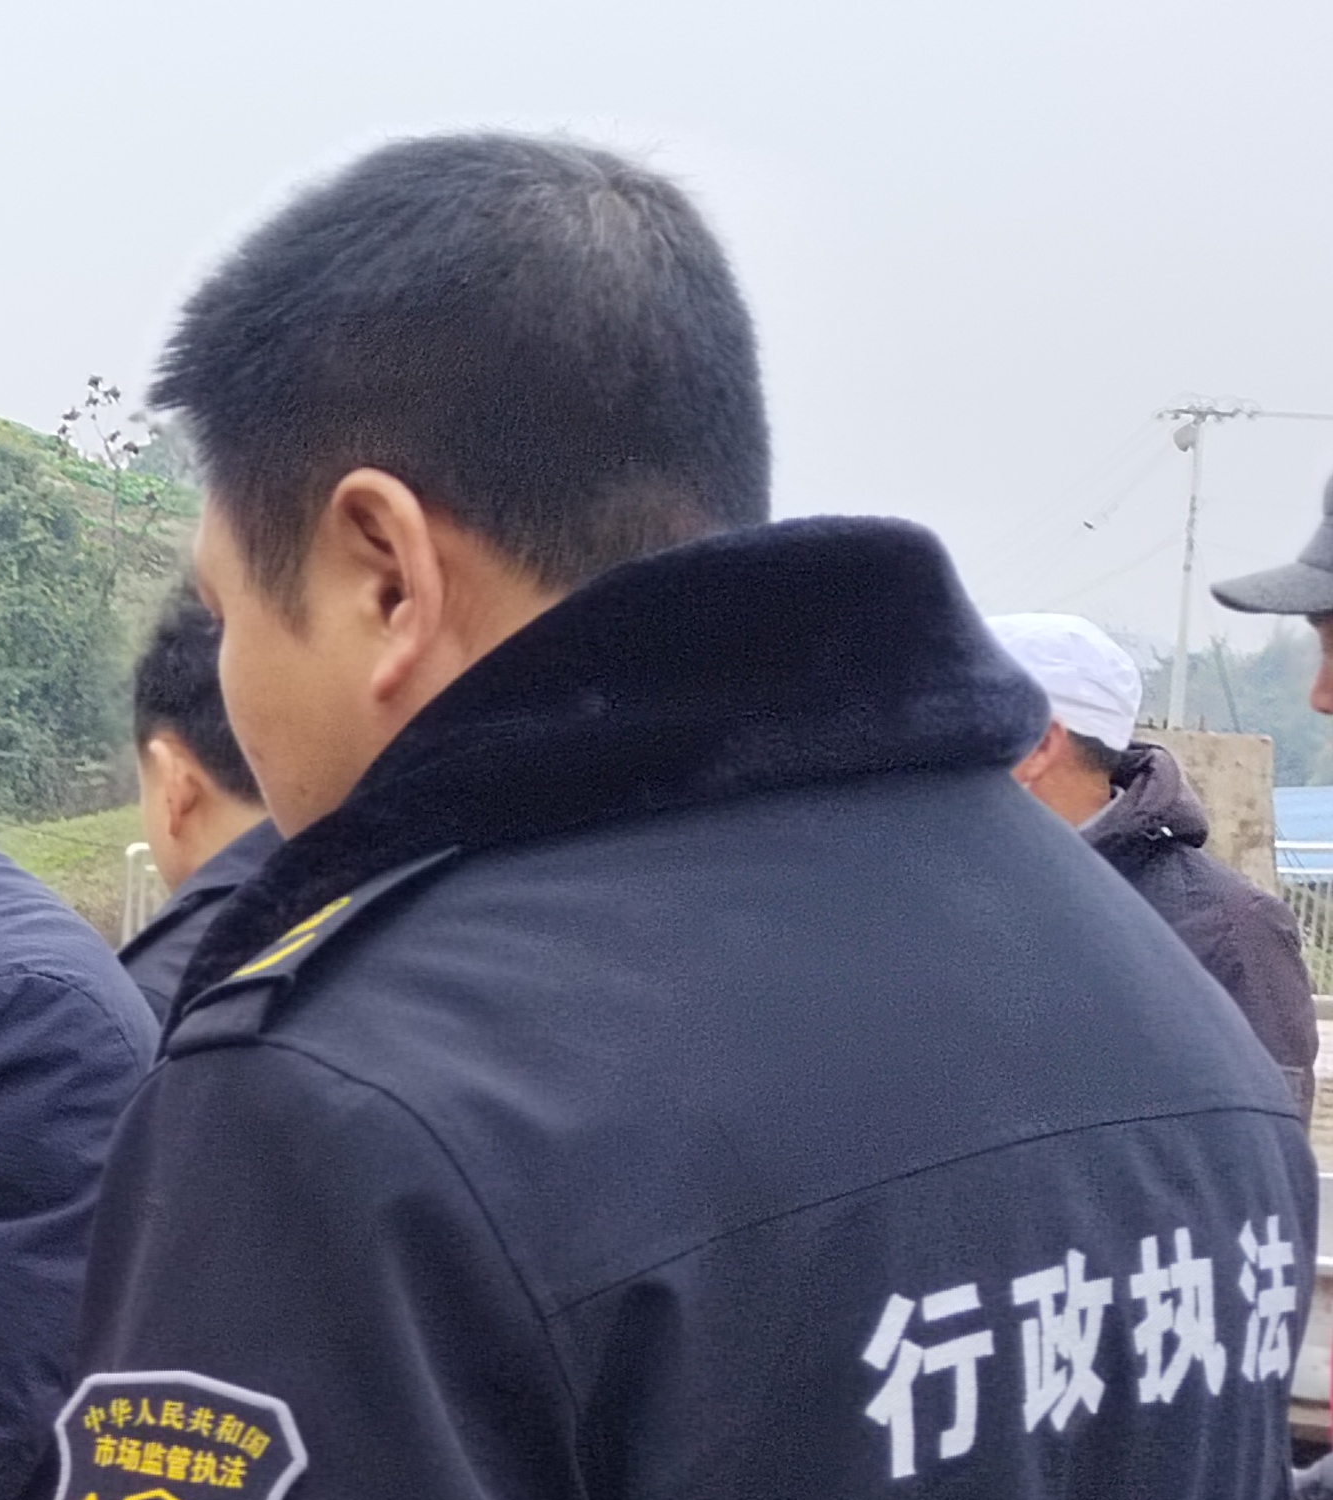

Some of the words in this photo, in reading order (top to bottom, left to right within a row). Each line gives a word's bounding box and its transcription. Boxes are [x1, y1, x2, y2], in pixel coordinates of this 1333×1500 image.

[862, 1215, 1297, 1479] 行政执法
[84, 1397, 271, 1460] 中华人民共和国
[94, 1434, 247, 1489] 市场监管执法
